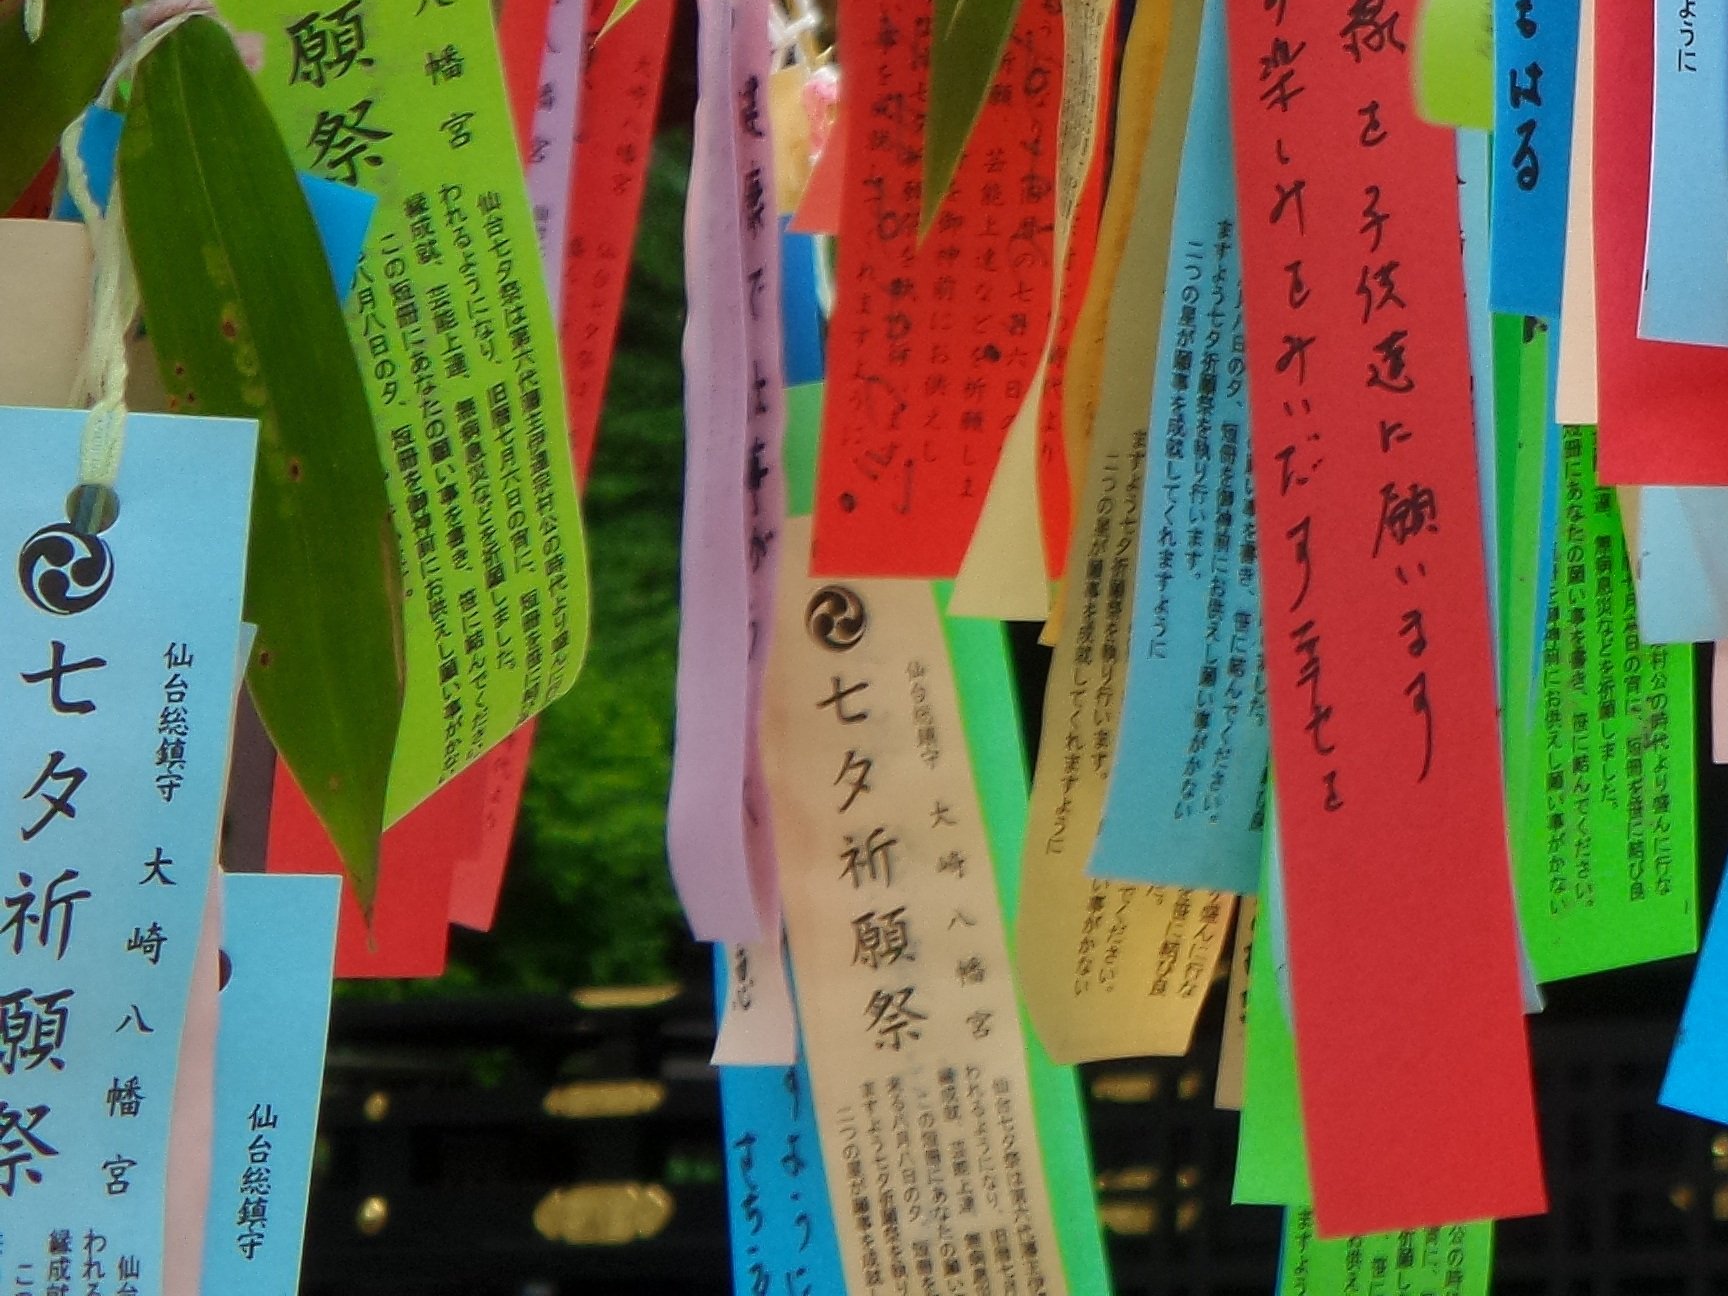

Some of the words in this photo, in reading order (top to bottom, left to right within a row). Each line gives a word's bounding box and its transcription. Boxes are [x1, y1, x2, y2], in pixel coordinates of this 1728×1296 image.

[155, 641, 196, 804] 仙台総鎮守
[815, 674, 929, 1053] 七夕祈願祭
[0, 640, 108, 1198] 七夕祈願祭
[100, 845, 179, 1197] 大崎八幡宮
[929, 799, 992, 1041] 大崎八幡宮
[236, 1103, 279, 1260] 仙台総鎮守
